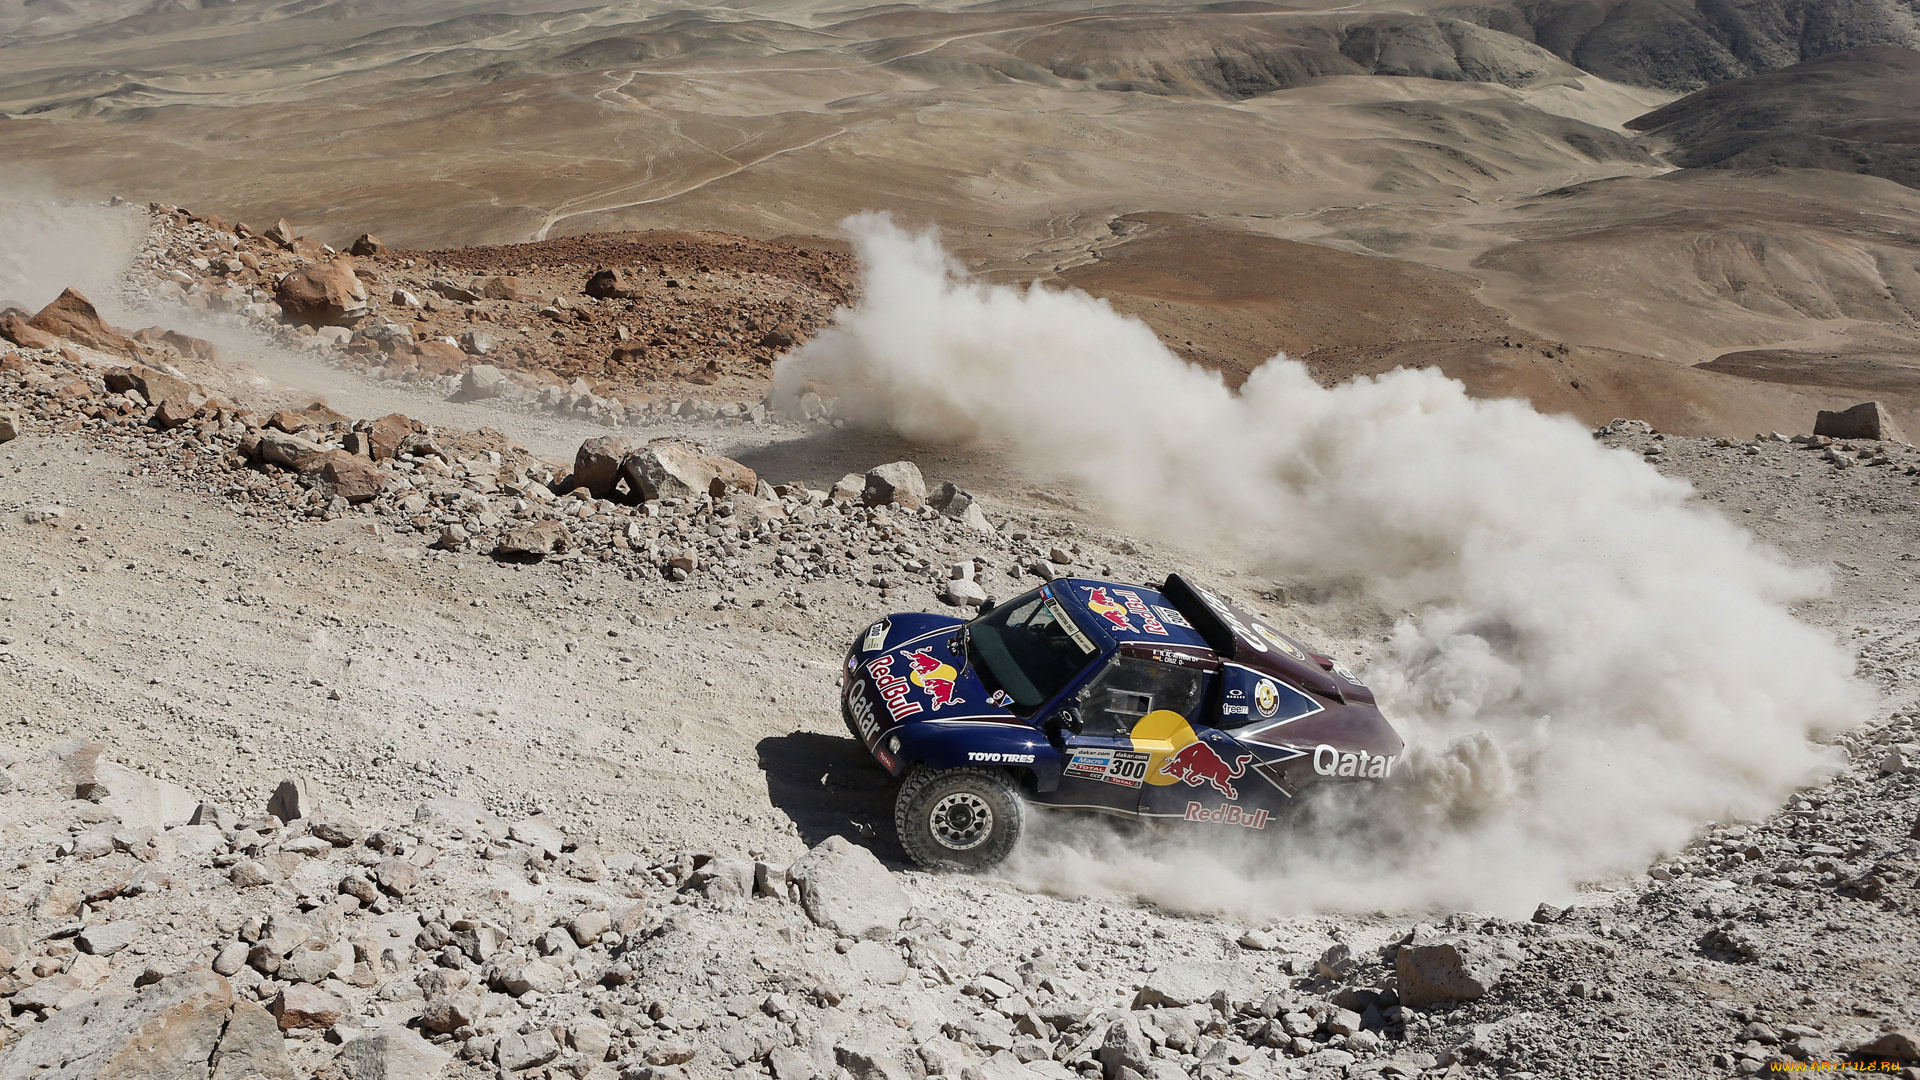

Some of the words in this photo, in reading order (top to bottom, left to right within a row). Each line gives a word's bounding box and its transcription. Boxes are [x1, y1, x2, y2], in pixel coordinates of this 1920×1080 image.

[1164, 656, 1177, 664] CRUZ
[849, 679, 880, 741] Qatar
[879, 751, 892, 767] TOTAL
[968, 752, 1001, 762] TOYO
[1002, 753, 1035, 763] TIRES
[1078, 757, 1104, 765] Macro
[1115, 752, 1148, 760] dakar.com
[1313, 744, 1396, 779] Qatar
[1078, 763, 1104, 772] TOTAL
[1109, 760, 1147, 779] 300
[1111, 777, 1134, 786] TOTAL
